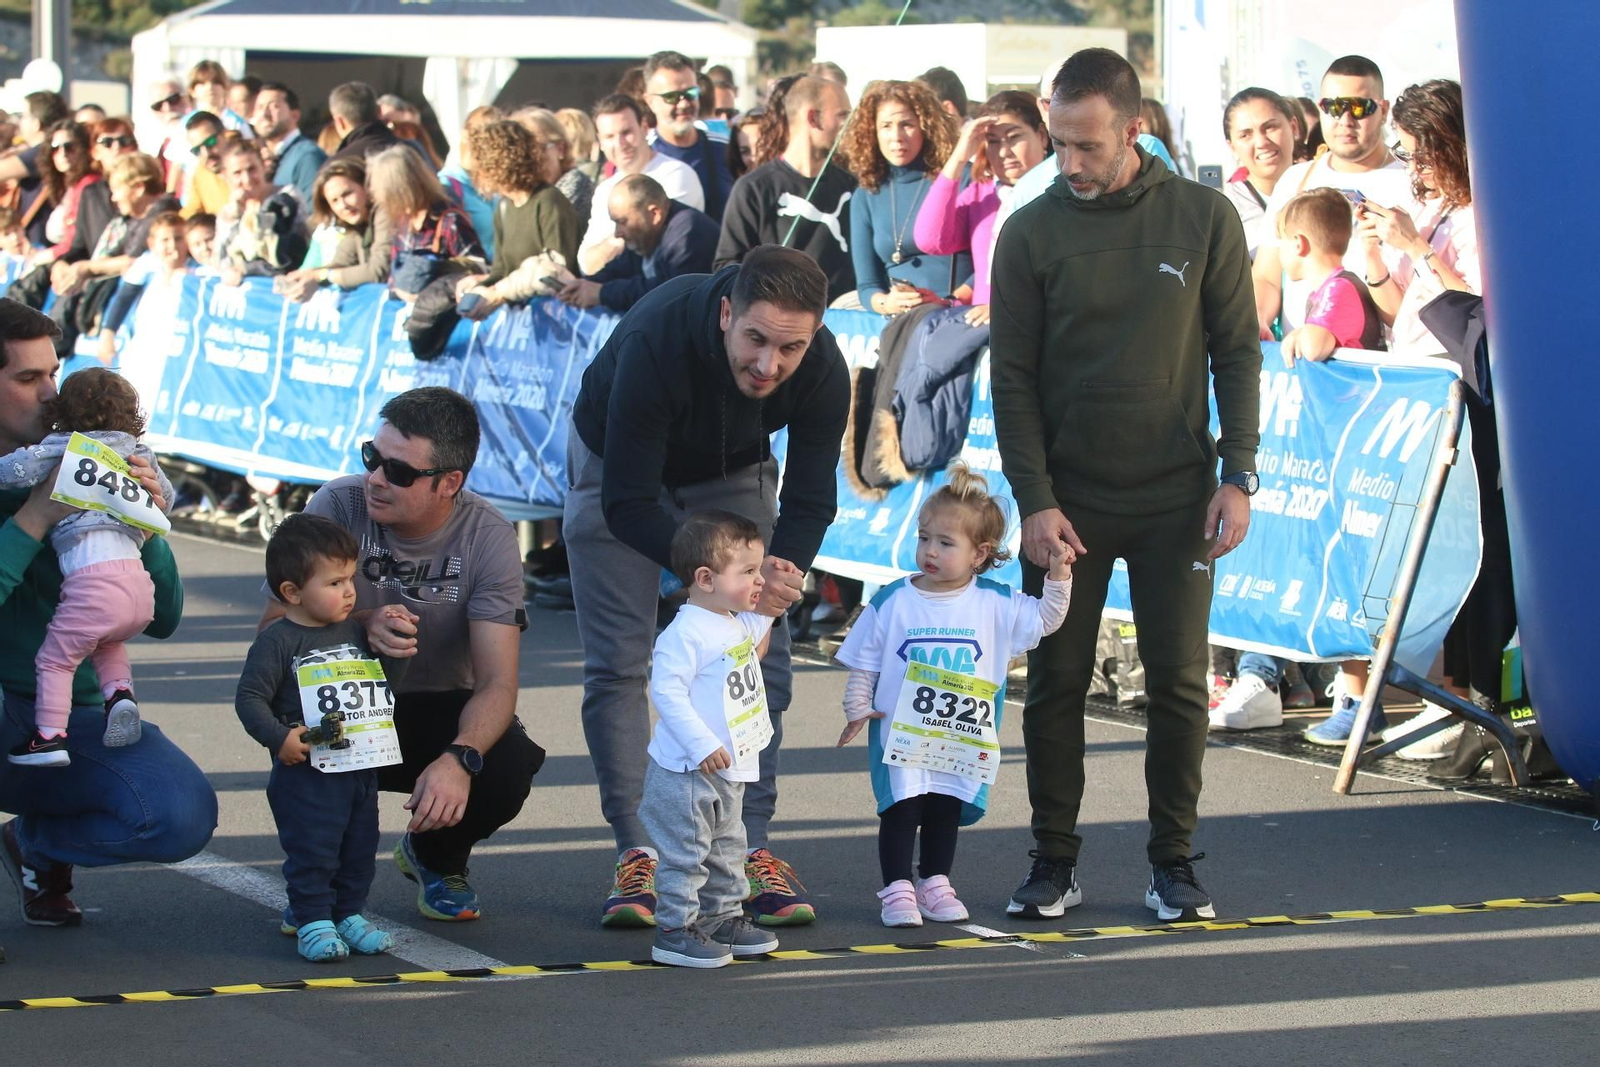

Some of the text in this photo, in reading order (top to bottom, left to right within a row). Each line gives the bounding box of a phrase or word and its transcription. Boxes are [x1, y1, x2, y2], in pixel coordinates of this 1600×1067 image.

[1347, 467, 1395, 500] Medio
[1284, 484, 1329, 521] 2020
[907, 627, 976, 637] SUPER RUNNER
[317, 681, 393, 714] 8377
[913, 686, 993, 729] 8322
[921, 716, 982, 736] ISABEL OLIVA
